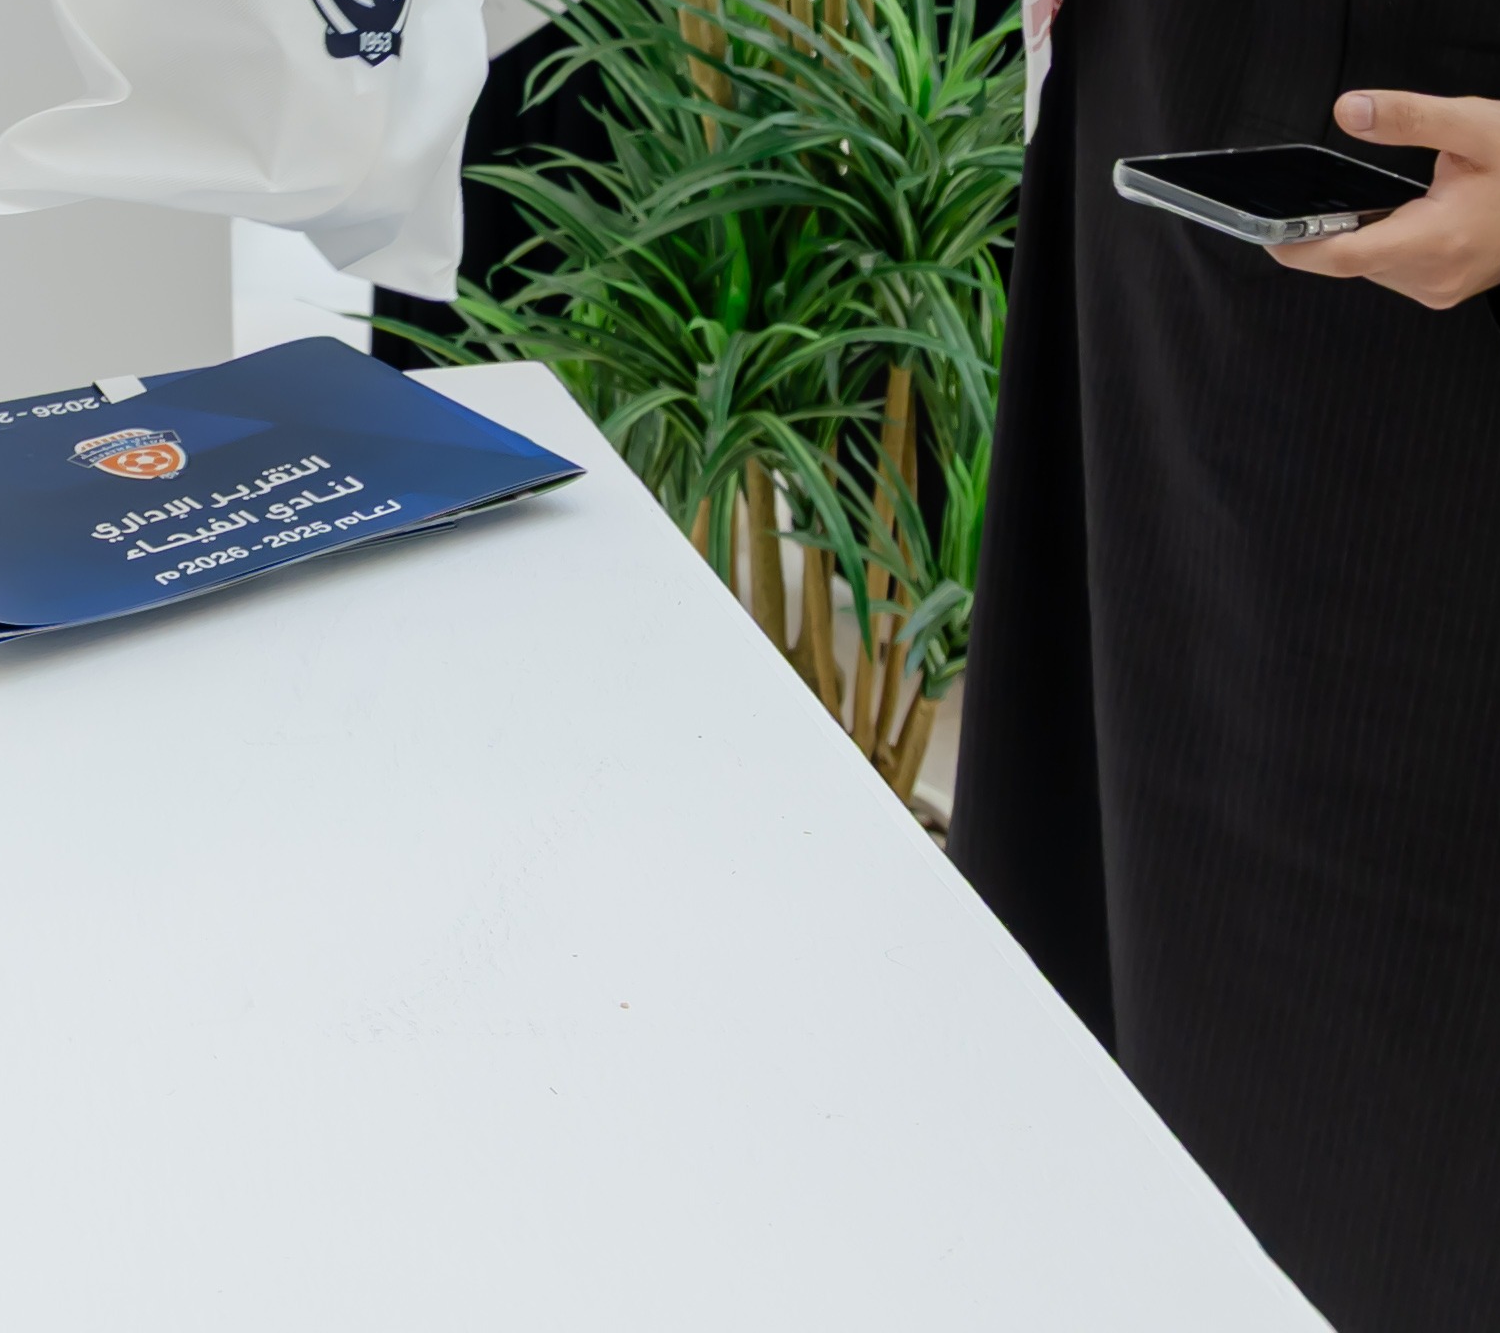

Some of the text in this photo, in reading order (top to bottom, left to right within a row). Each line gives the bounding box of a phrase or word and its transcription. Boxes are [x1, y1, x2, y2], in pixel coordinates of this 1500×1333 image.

[91, 454, 332, 544] التقرير الإداري
[126, 475, 365, 562] لنادي الفيحاء
[334, 498, 402, 531] لعام
[262, 520, 333, 550] 2025
